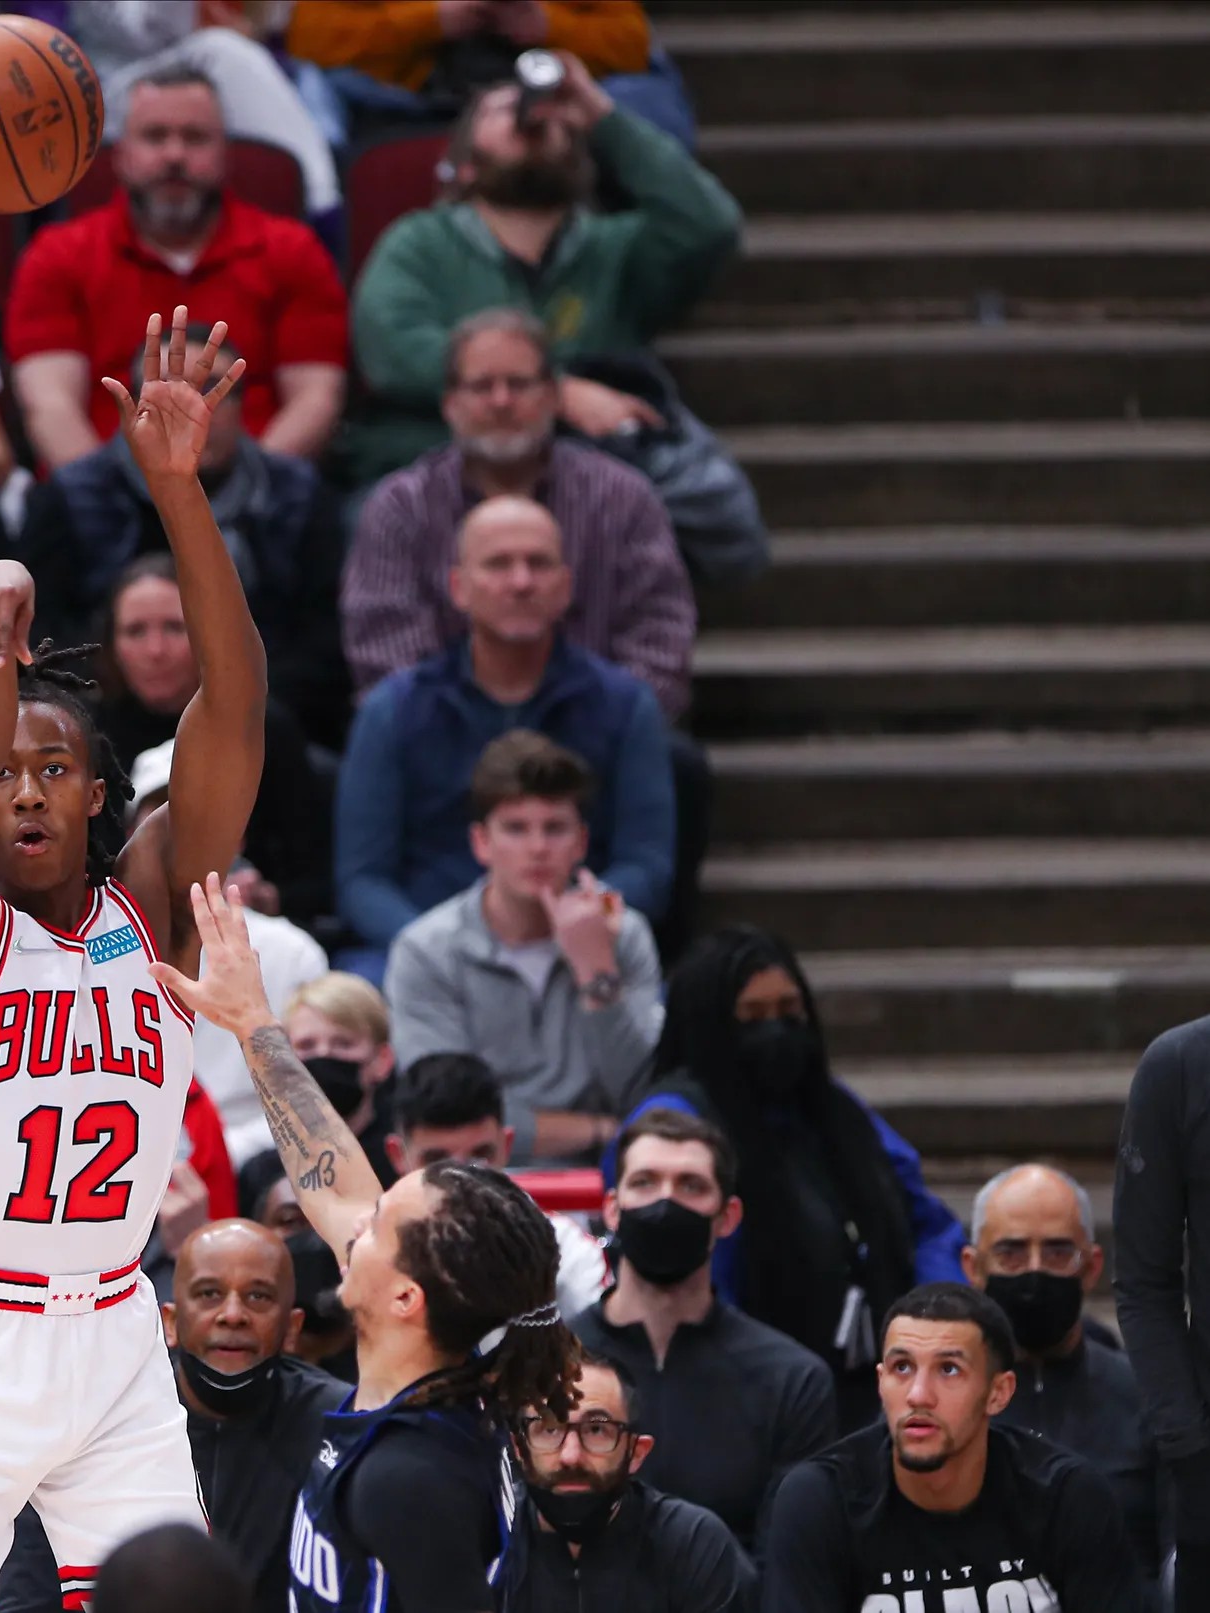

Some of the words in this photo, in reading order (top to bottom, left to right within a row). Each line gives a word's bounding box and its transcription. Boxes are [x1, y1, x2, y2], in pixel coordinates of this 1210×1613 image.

[86, 927, 135, 953] ZENNI
[91, 940, 139, 963] EYEWEAR
[3, 1100, 139, 1224] 12
[882, 1565, 973, 1585] BUILT
[999, 1559, 1025, 1573] BY
